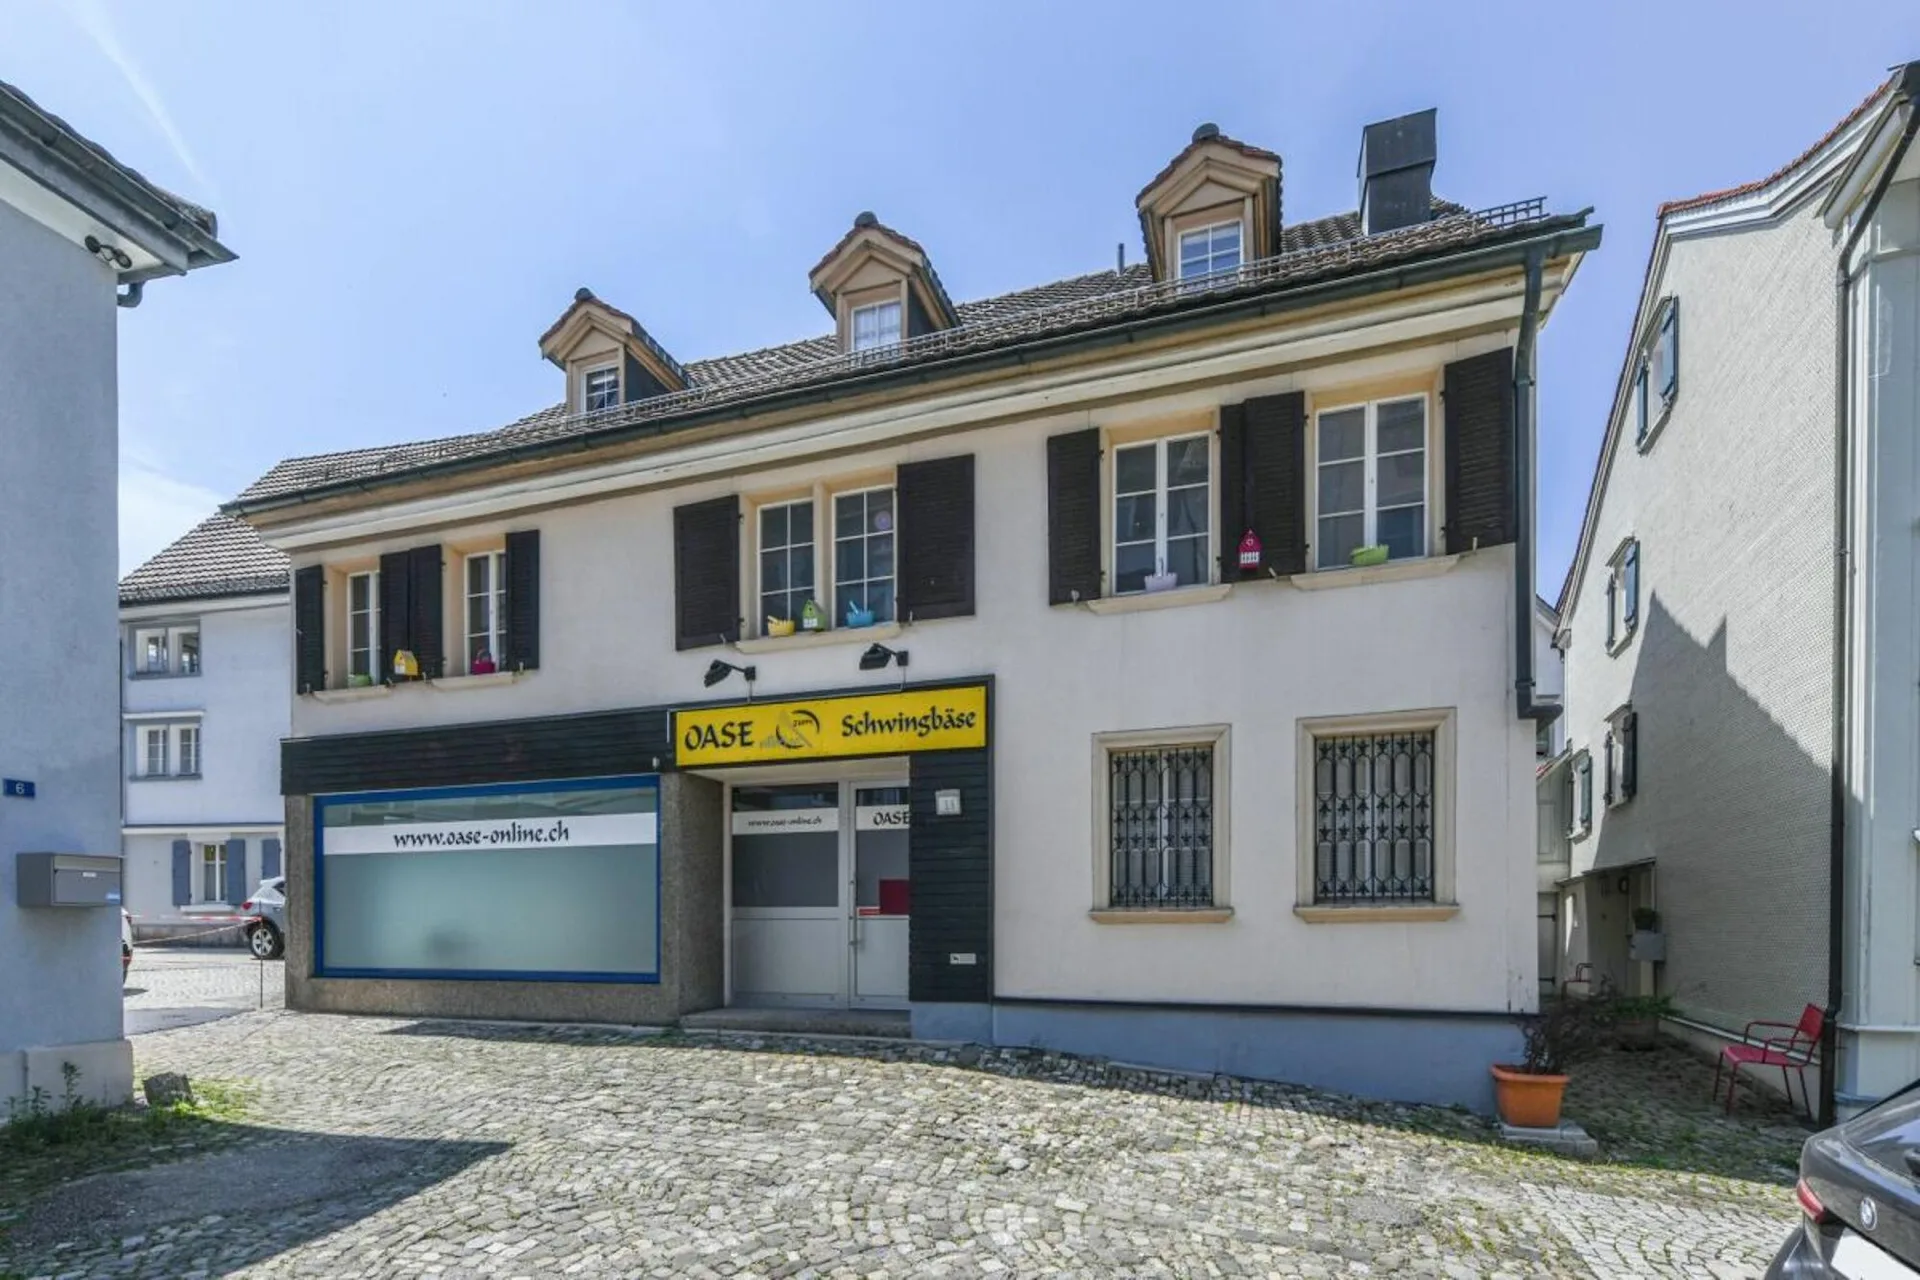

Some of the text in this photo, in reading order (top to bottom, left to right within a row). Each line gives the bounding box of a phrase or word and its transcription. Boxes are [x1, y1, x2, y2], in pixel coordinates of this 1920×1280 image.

[841, 706, 976, 737] Schwingbäse
[685, 721, 754, 750] OASE
[16, 782, 25, 794] 6
[394, 821, 569, 847] www.oase-online.ch
